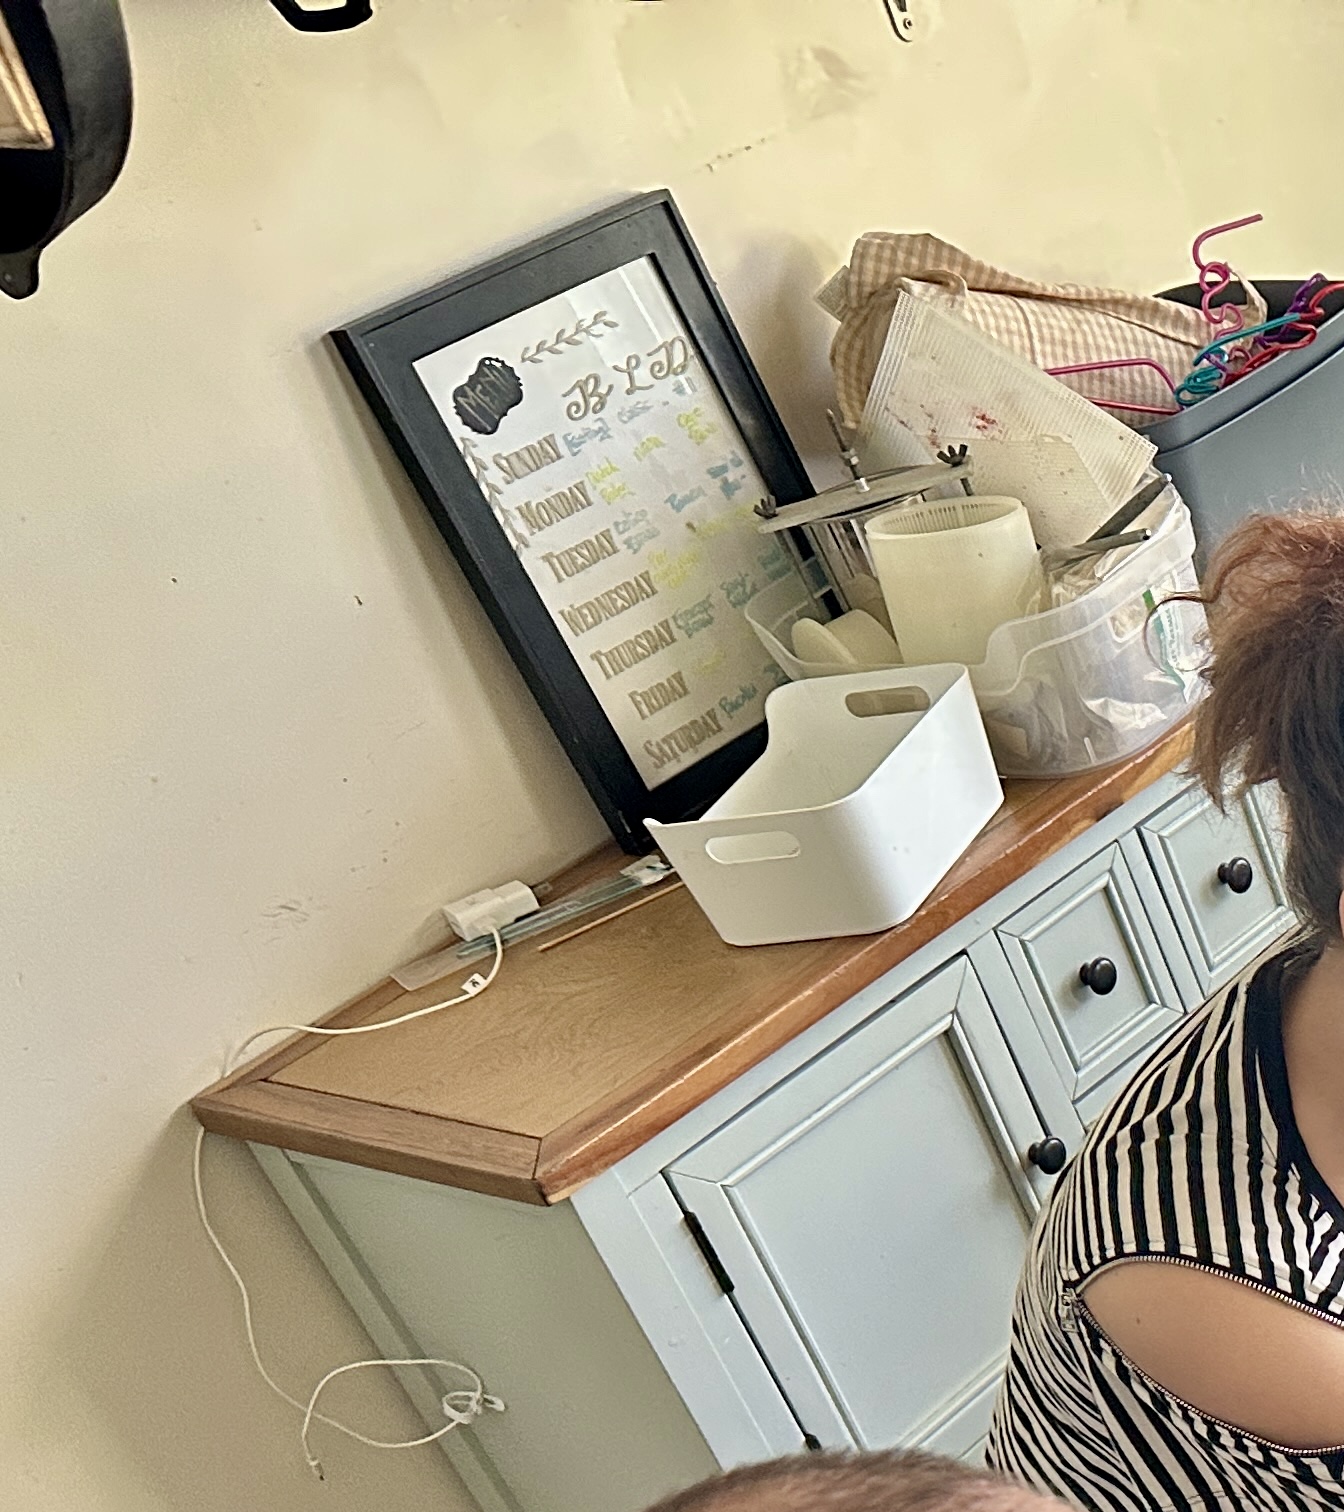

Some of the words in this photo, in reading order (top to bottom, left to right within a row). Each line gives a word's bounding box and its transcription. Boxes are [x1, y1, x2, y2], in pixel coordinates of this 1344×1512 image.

[561, 373, 614, 421] B
[612, 354, 655, 395] L
[646, 335, 690, 380] D
[627, 670, 690, 720] FRIDAY
